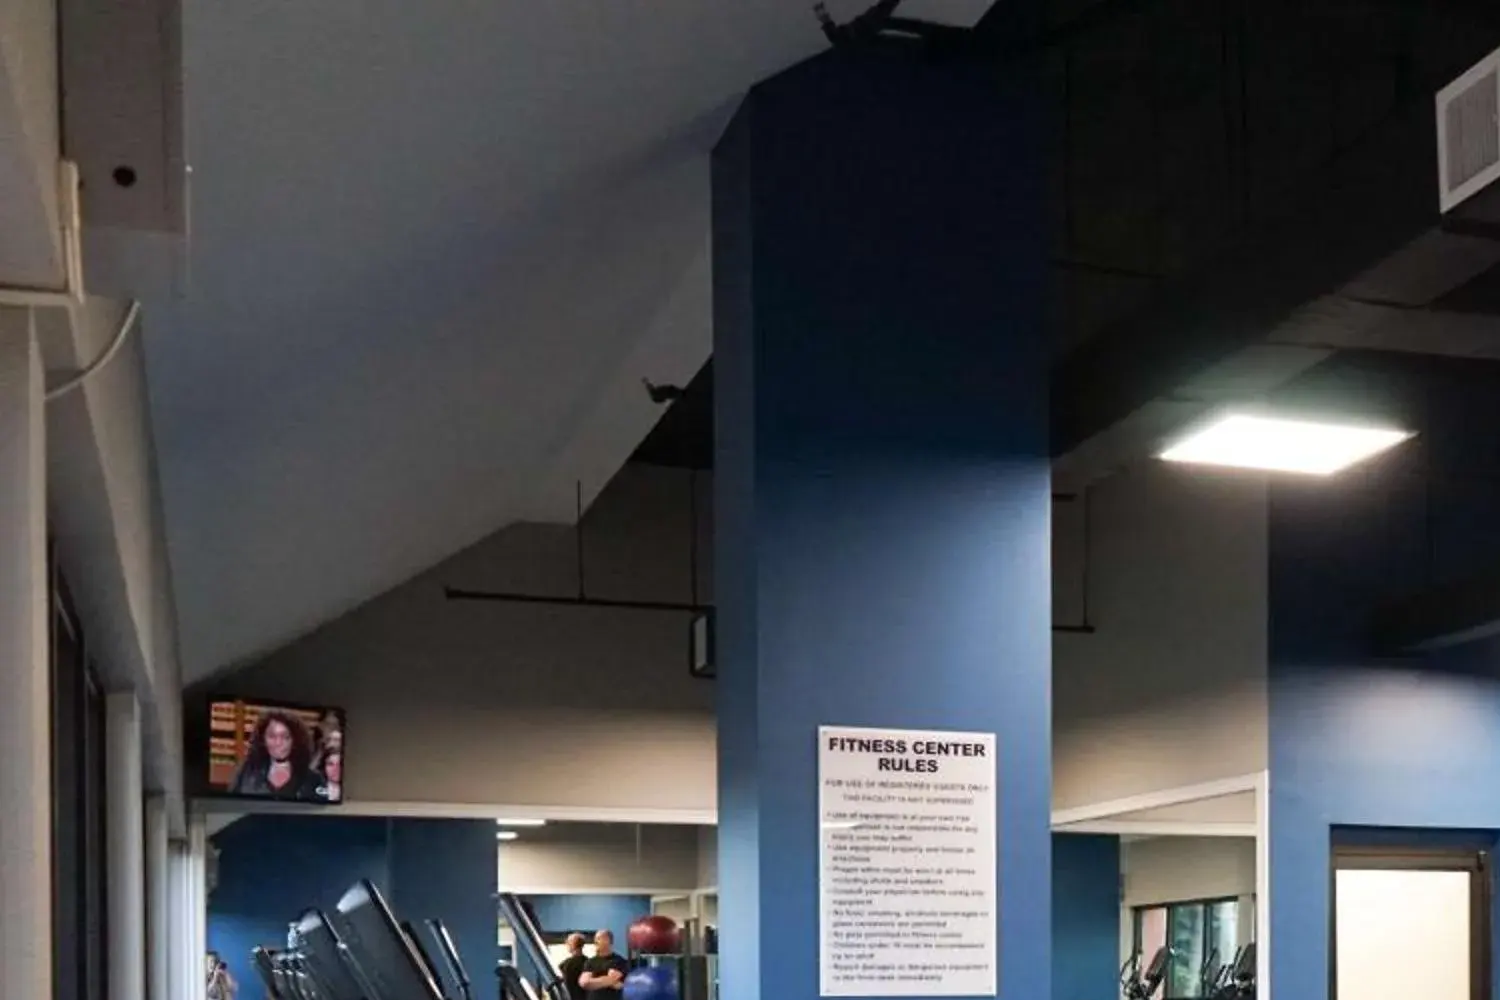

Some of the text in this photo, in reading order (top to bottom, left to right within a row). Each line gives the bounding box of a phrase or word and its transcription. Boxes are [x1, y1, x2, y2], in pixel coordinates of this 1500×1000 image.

[828, 737, 986, 757] FITNESS CENTER
[878, 757, 939, 773] RULES
